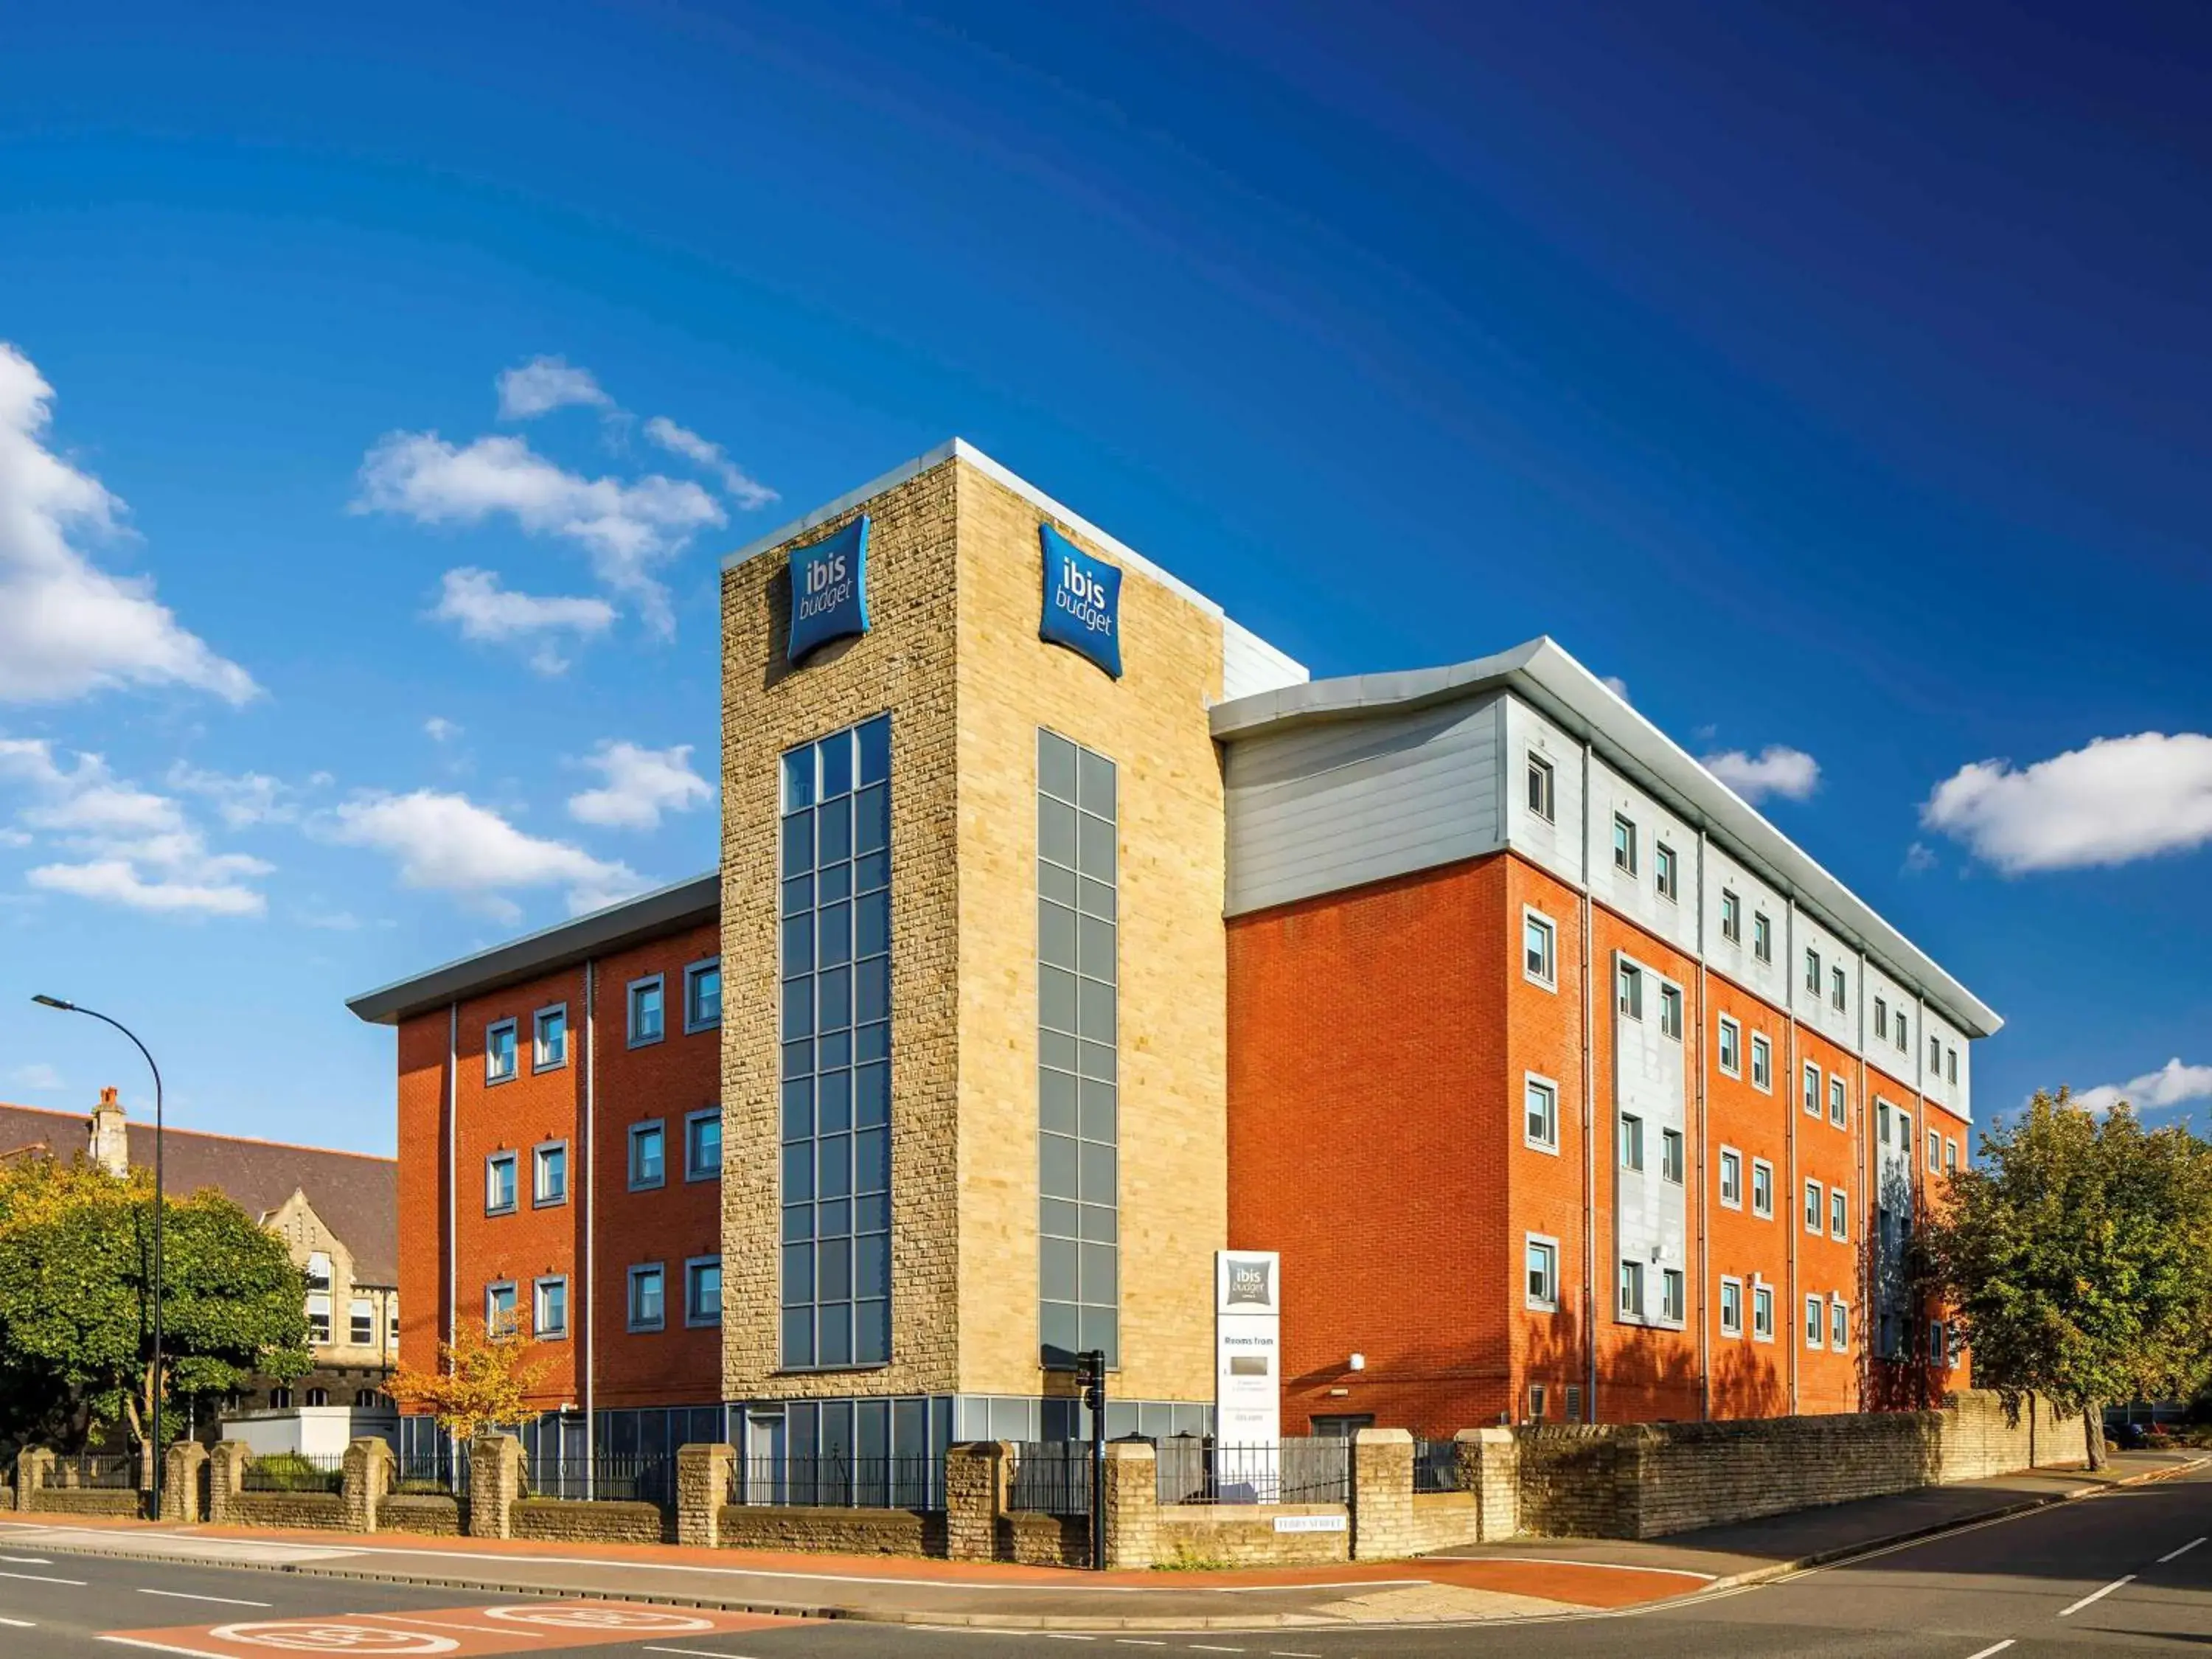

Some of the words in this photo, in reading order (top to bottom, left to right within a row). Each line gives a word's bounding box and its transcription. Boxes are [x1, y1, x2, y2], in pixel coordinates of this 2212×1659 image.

[807, 552, 846, 595] ibis
[1064, 555, 1105, 610] ibis
[799, 577, 853, 620] budget
[1055, 583, 1113, 636] budget
[1237, 1267, 1261, 1283] ibis
[1225, 1336, 1253, 1345] Rooms
[1254, 1336, 1274, 1345] from
